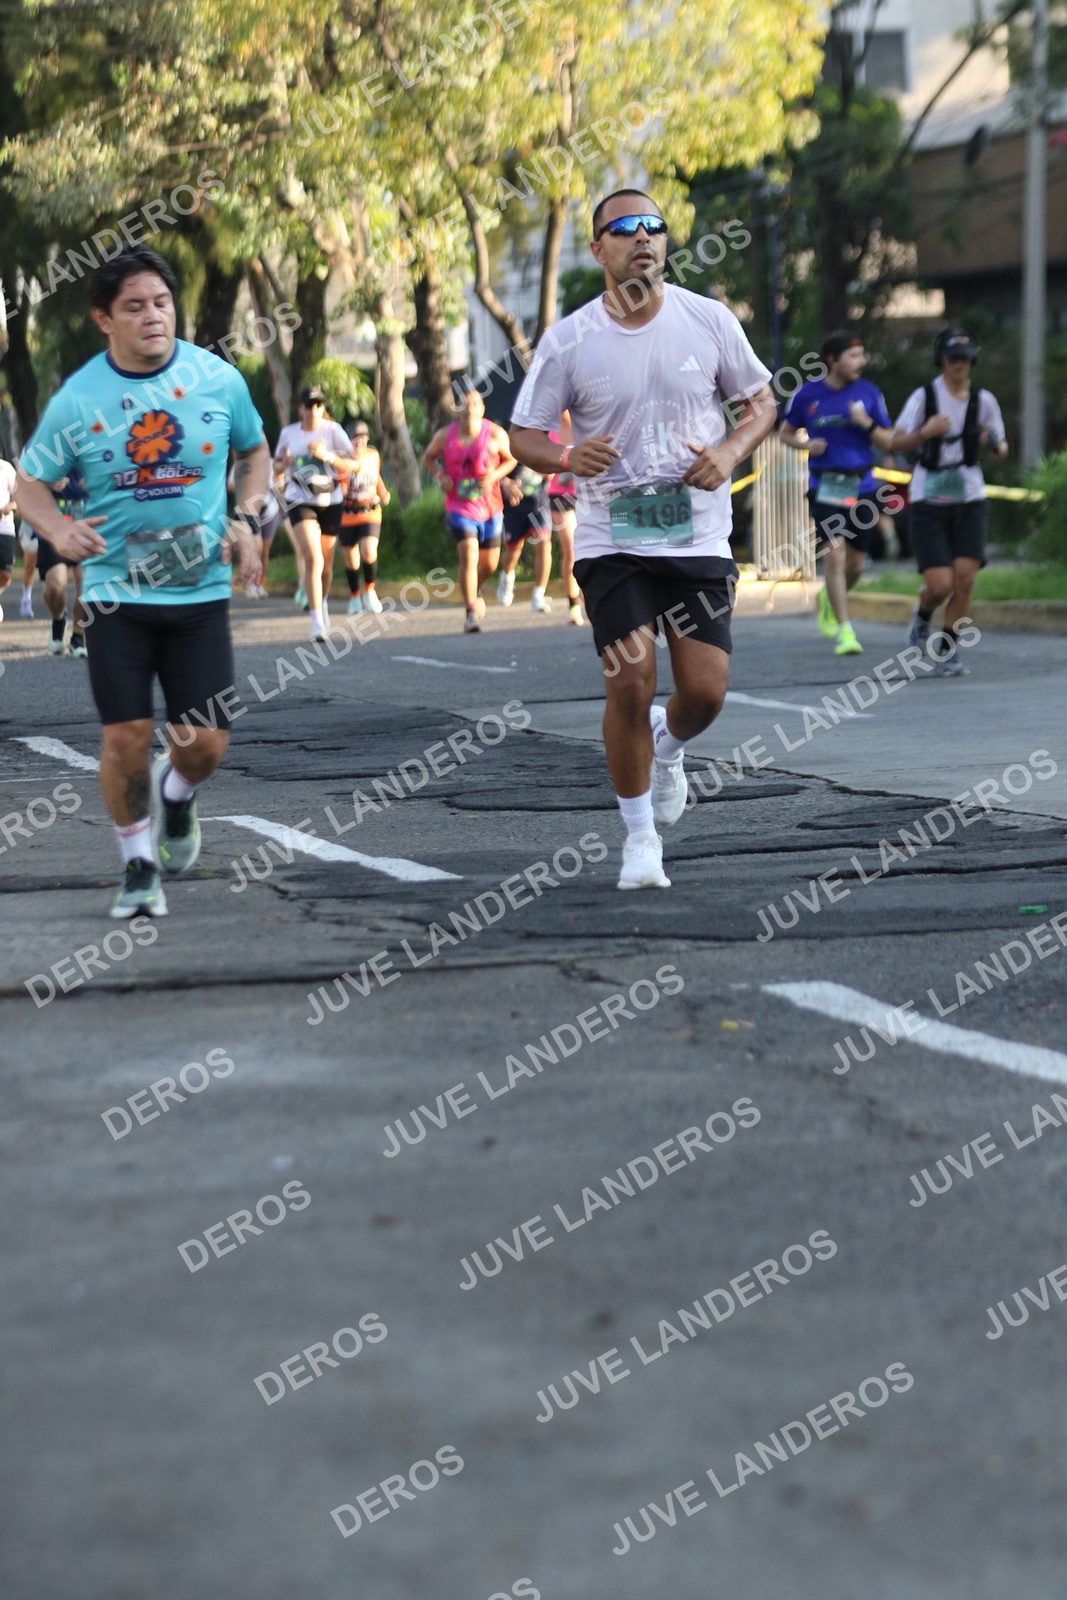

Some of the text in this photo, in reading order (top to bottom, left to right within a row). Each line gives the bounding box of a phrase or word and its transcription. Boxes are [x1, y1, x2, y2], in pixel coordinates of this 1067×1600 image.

[641, 424, 655, 439] 15
[641, 443, 657, 458] 30
[156, 468, 202, 479] GOLFO
[633, 501, 691, 529] 1196
